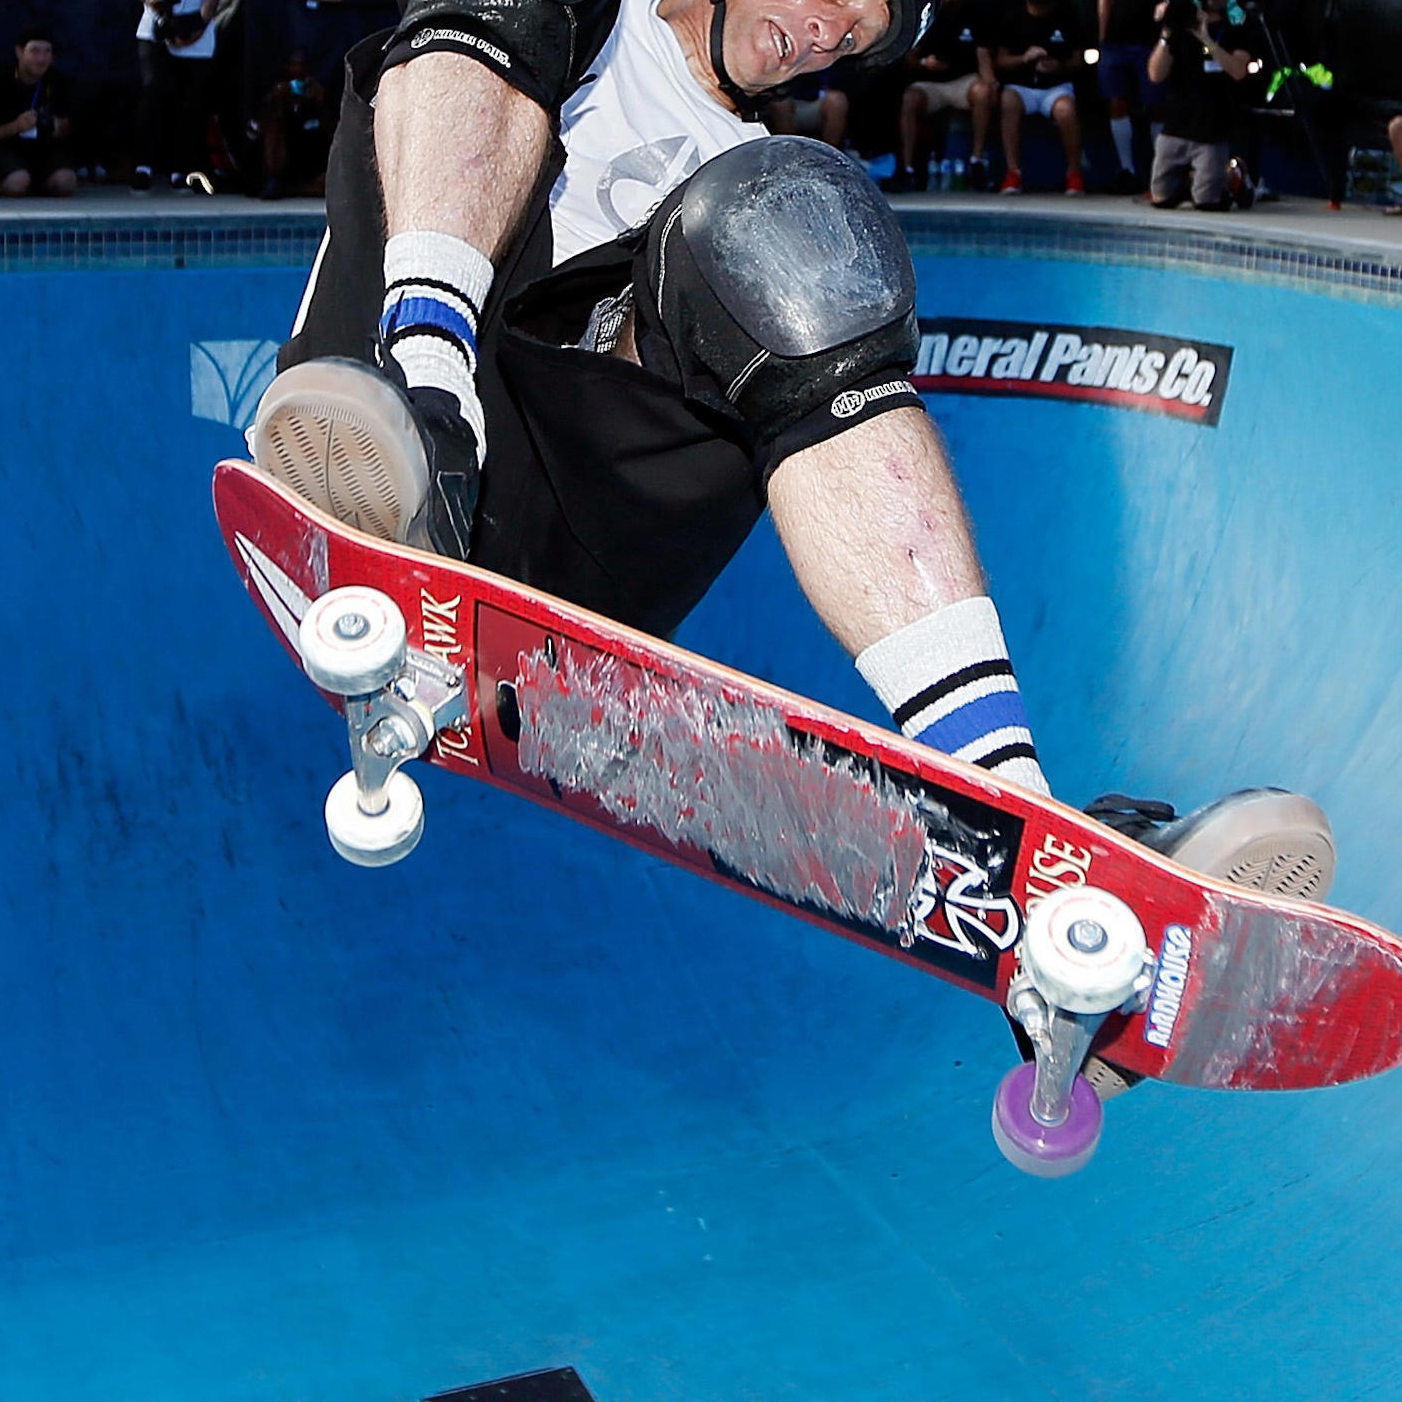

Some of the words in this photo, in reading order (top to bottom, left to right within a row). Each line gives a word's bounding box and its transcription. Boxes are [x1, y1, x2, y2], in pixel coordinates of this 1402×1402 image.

[914, 331, 1050, 381] neral
[1046, 332, 1166, 395] Pants
[1158, 347, 1217, 407] Co.
[420, 587, 462, 665] AWK
